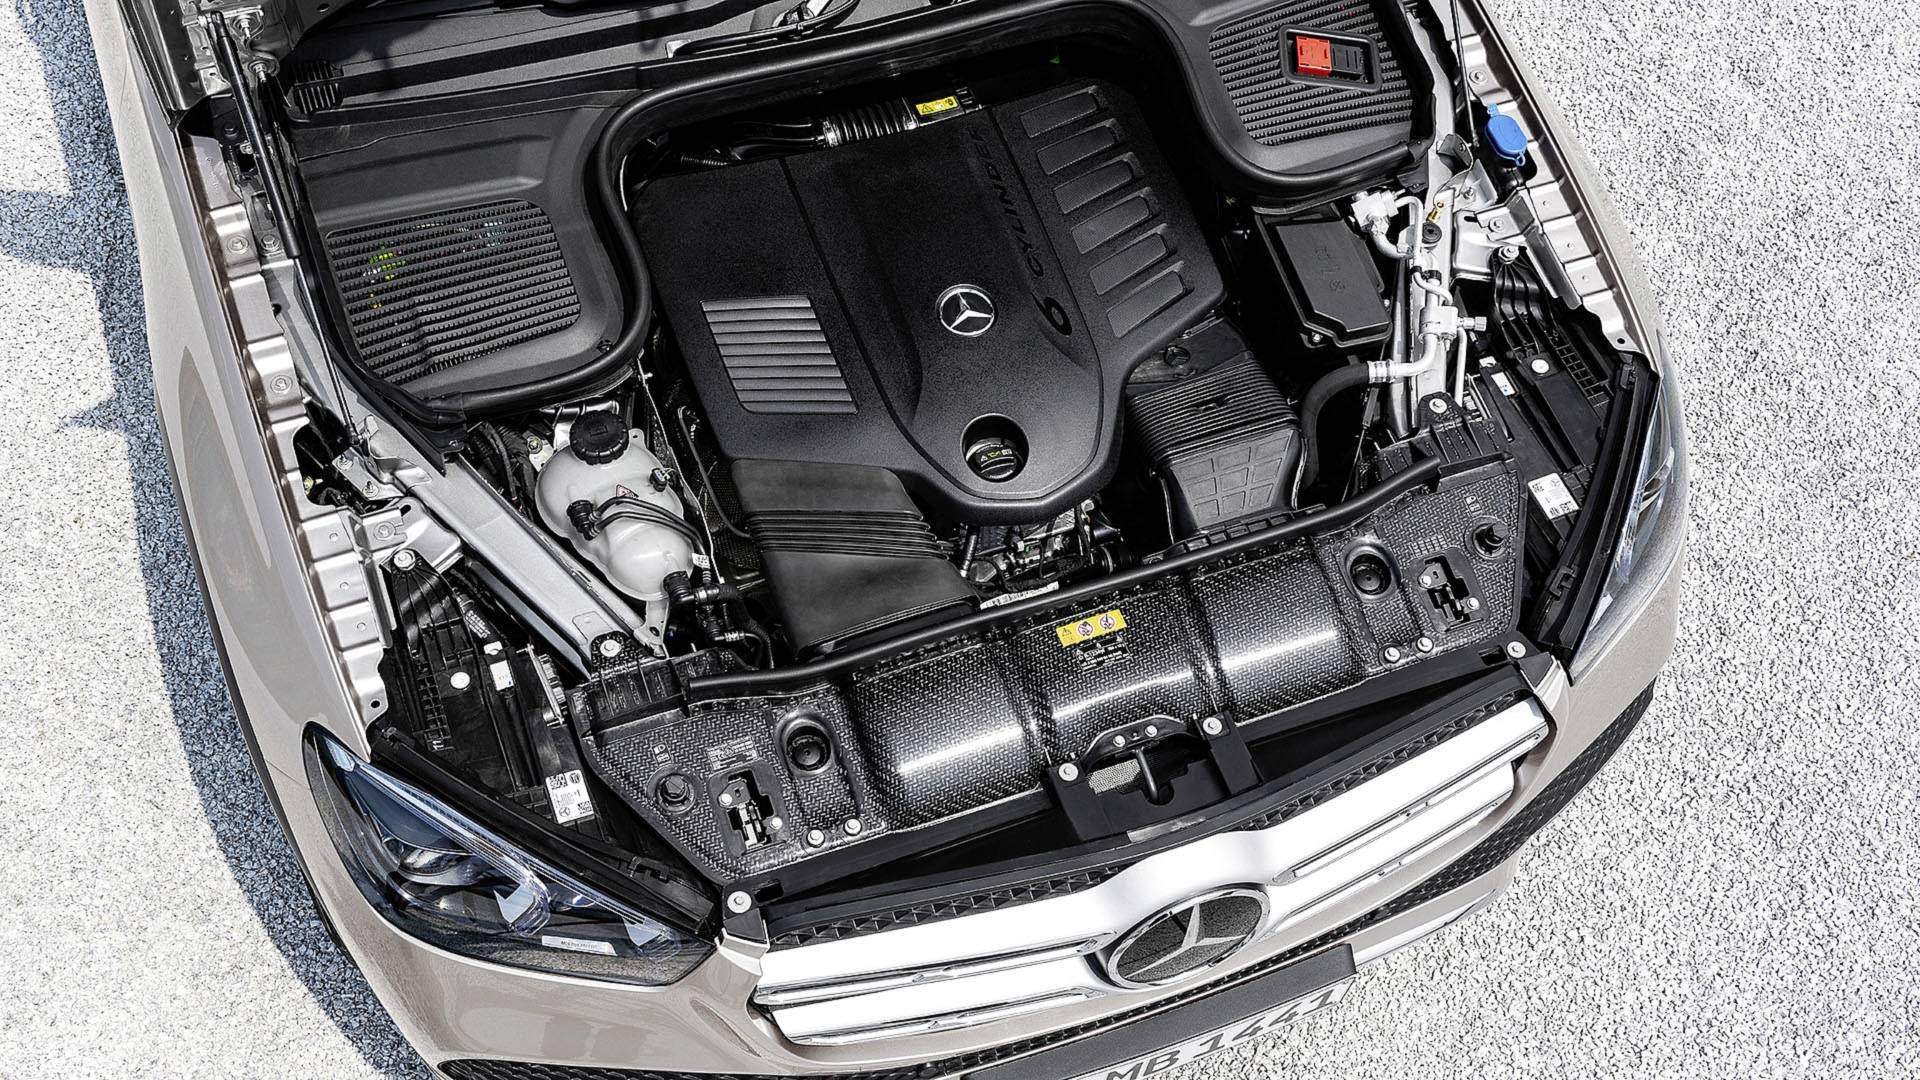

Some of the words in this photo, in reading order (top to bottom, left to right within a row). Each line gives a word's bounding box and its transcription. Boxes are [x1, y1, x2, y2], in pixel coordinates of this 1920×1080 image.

[1031, 291, 1072, 336] 6
[1106, 1050, 1180, 1080] MB
[1193, 989, 1334, 1058] 1441
